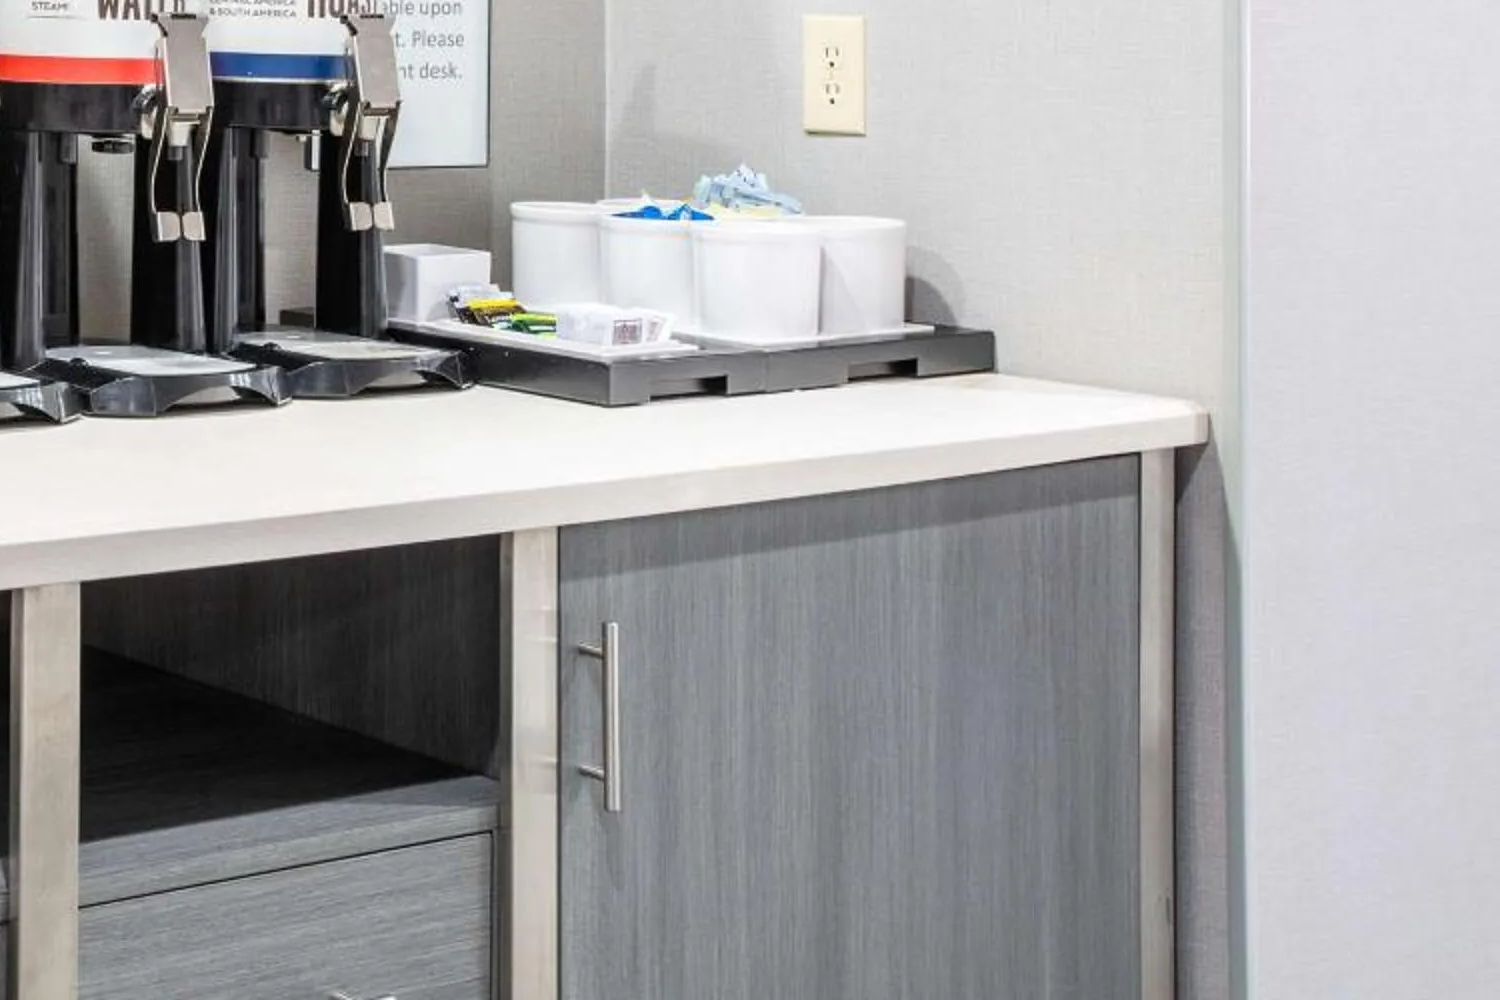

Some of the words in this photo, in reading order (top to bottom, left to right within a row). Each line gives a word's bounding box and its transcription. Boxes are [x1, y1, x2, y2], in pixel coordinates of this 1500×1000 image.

[419, 1, 463, 18] upon
[411, 30, 465, 48] Please
[420, 62, 463, 80] desk.
